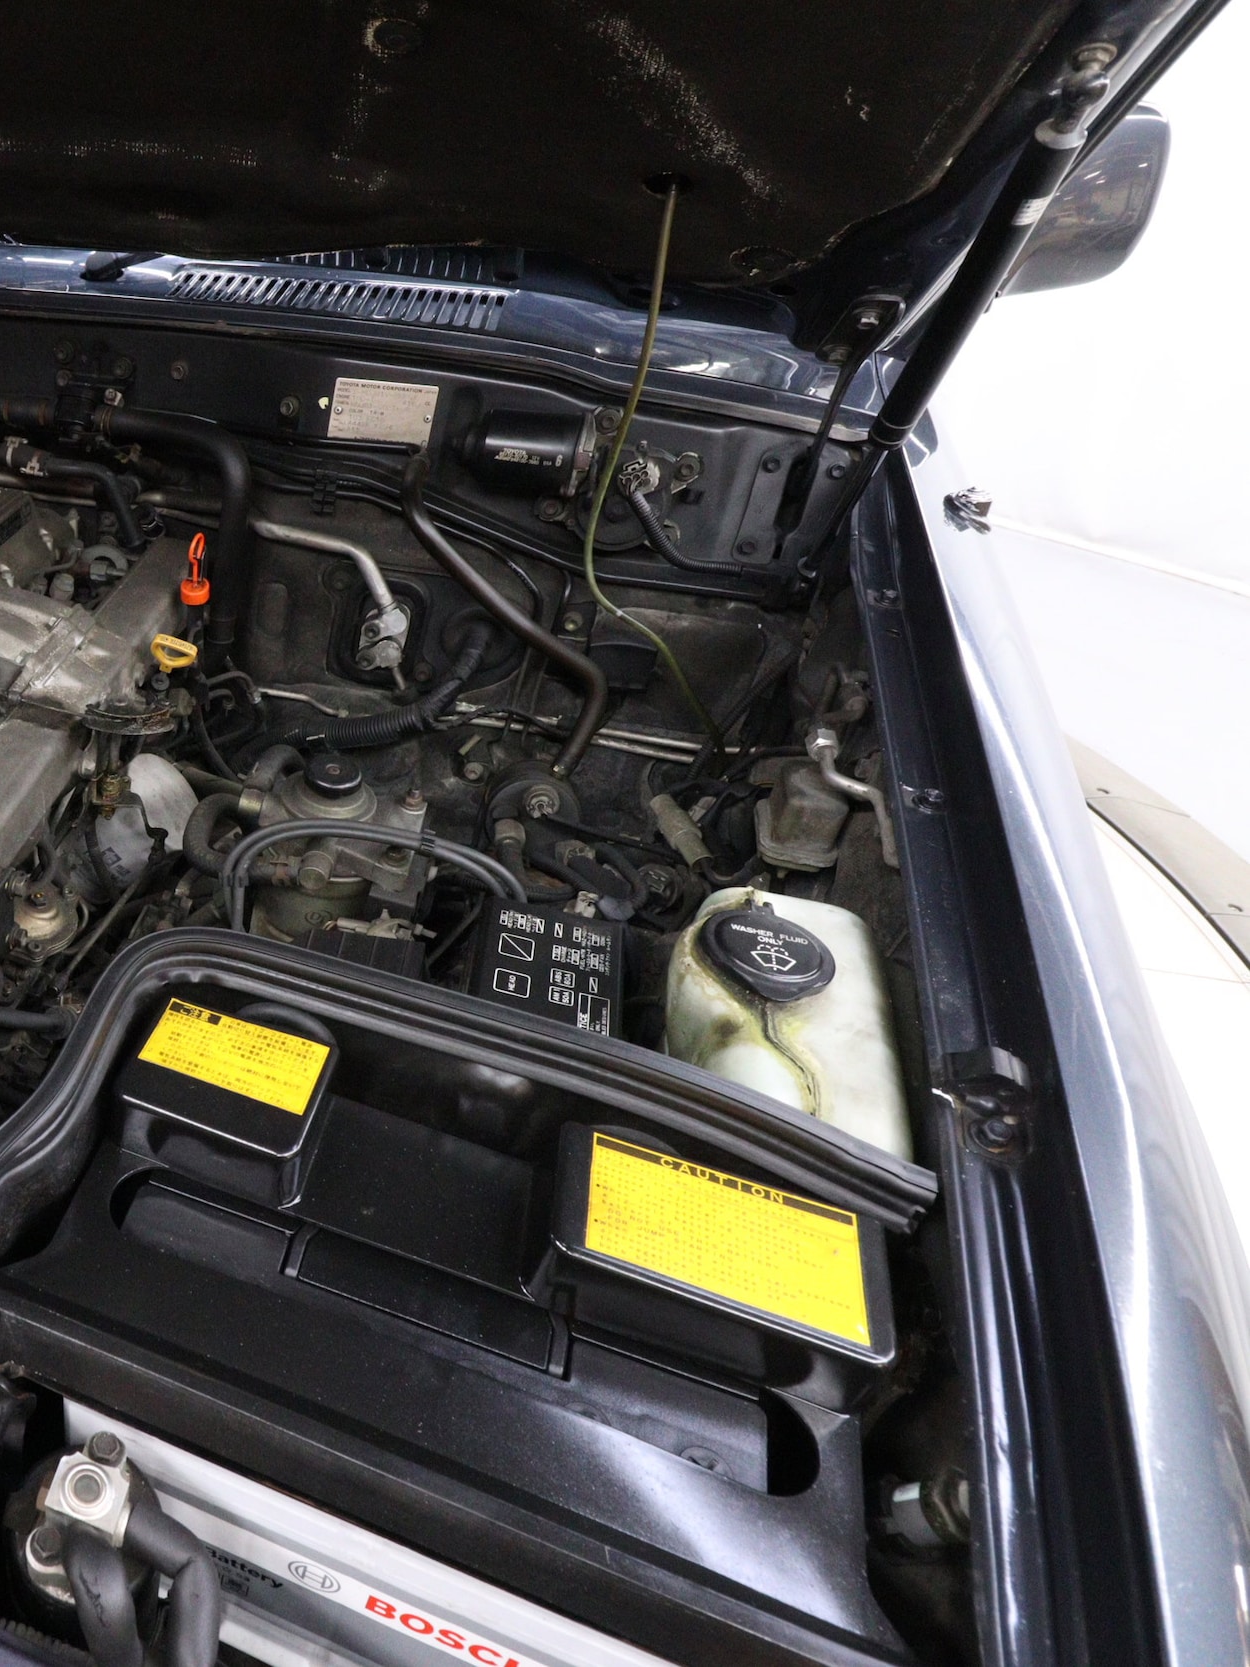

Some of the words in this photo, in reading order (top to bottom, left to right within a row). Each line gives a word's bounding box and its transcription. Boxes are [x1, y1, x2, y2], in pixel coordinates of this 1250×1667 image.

[382, 385, 423, 393] CORPORATION
[730, 923, 774, 938] WASHER
[779, 933, 809, 945] FLUID
[757, 935, 784, 946] ONLY
[508, 975, 516, 991] HEAD
[554, 971, 562, 983] ABS
[179, 1005, 212, 1022] ご注意
[579, 1012, 588, 1029] TICE
[659, 1157, 785, 1205] CAUTION
